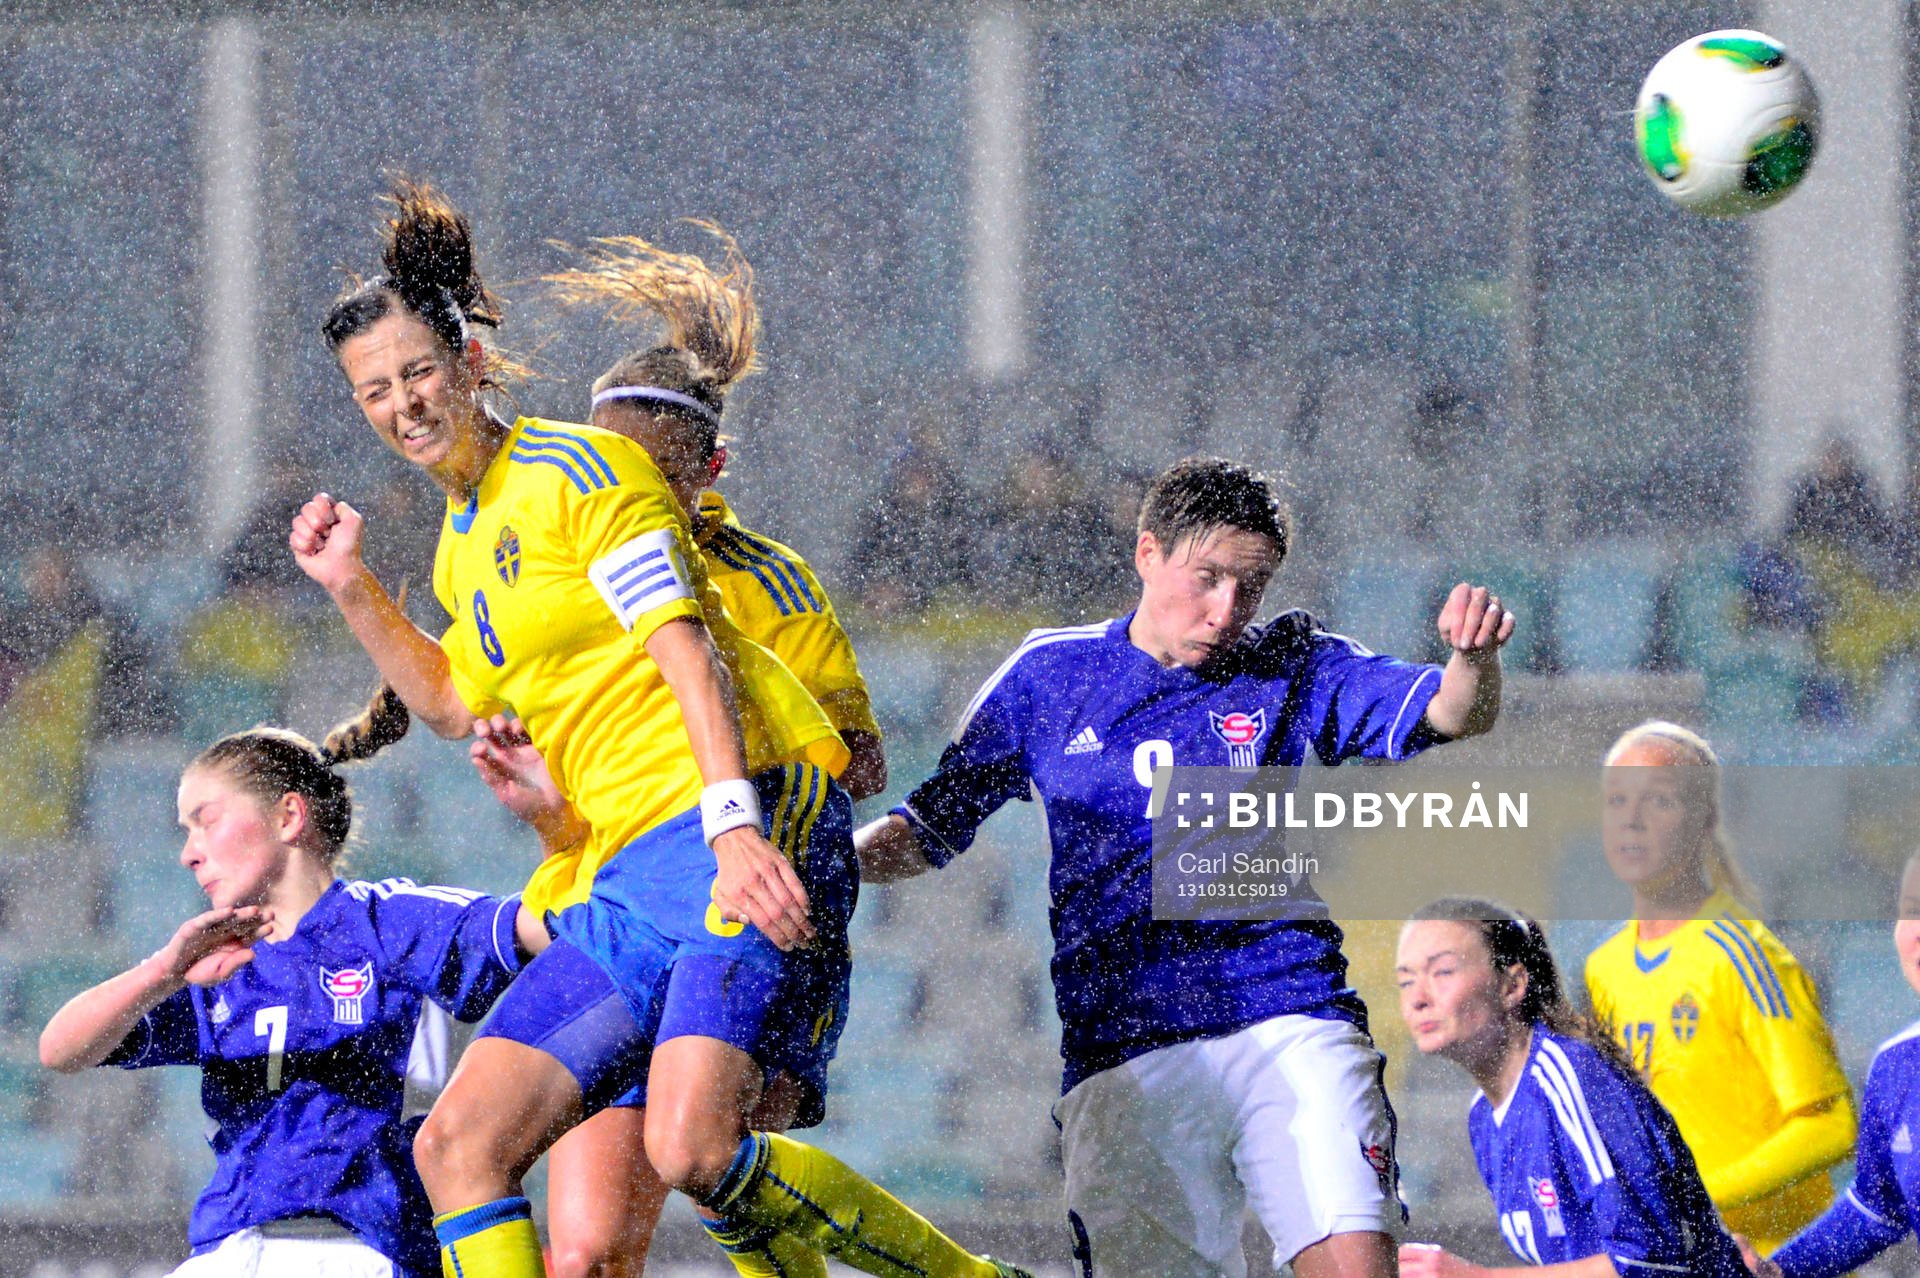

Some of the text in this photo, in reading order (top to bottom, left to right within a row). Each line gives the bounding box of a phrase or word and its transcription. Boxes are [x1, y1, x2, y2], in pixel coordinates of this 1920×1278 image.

[473, 589, 505, 667] 8
[1064, 741, 1104, 755] adidas
[1133, 739, 1174, 819] 9
[254, 1005, 289, 1092] 7
[1622, 1022, 1655, 1081] 17
[1501, 1210, 1543, 1266] 17
